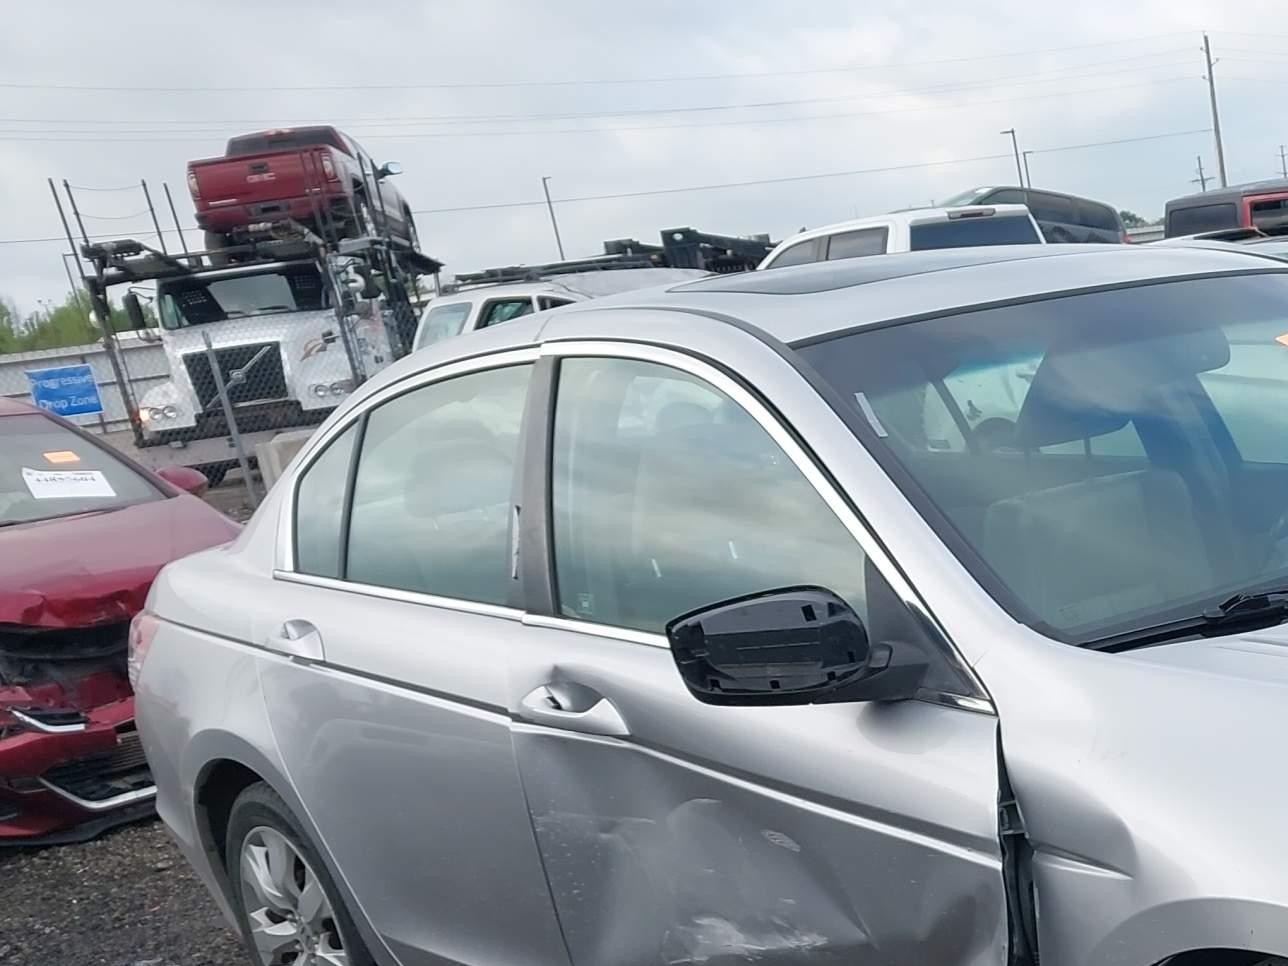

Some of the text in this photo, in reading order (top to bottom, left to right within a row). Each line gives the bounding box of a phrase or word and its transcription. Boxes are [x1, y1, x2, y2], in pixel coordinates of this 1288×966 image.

[246, 172, 276, 183] GMC
[30, 375, 93, 390] Progressive
[38, 395, 99, 410] Drop Zone
